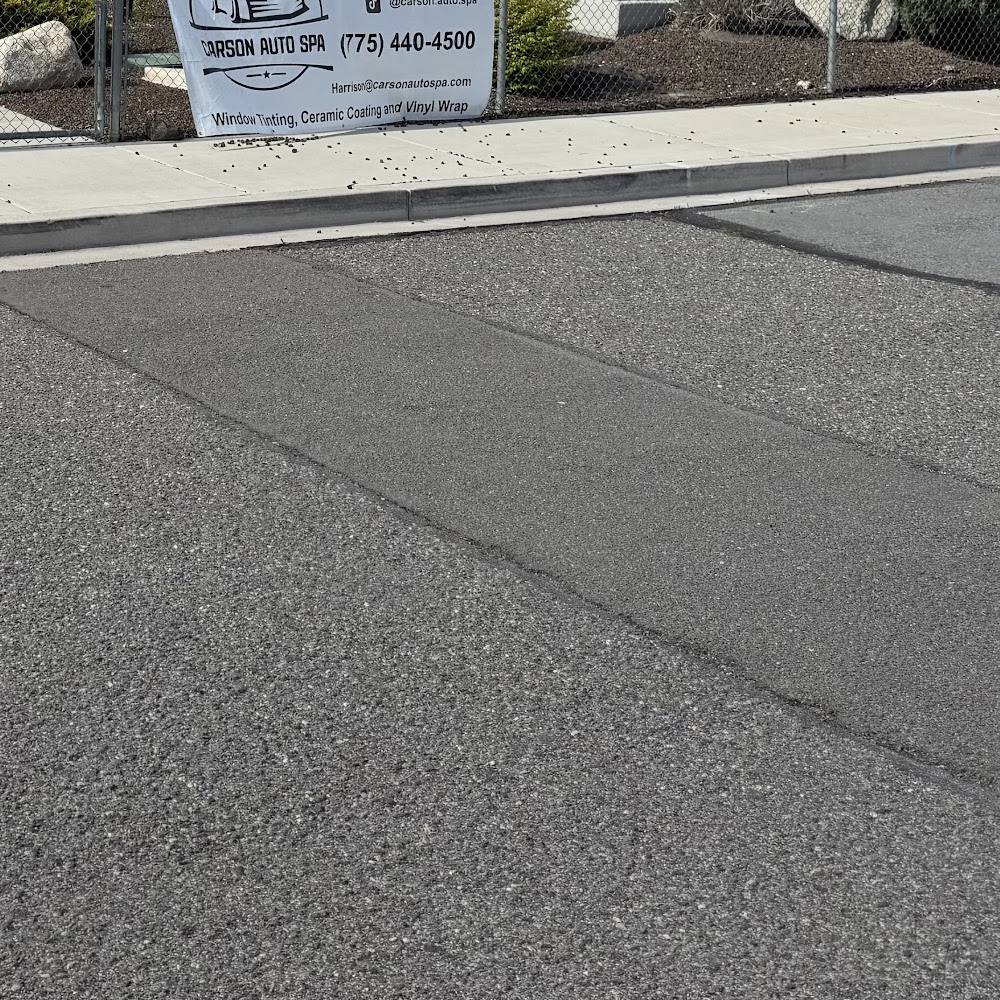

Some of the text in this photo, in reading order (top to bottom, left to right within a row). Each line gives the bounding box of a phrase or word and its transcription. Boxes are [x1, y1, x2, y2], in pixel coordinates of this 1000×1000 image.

[201, 34, 326, 58] CARSON AUTO SPA
[340, 30, 476, 59] (775) 440-4500
[331, 78, 472, 94] Harrison@carsonautospa.com
[211, 99, 469, 128] Window Tinting, Ceramic Coating and Vinyl Wrap
